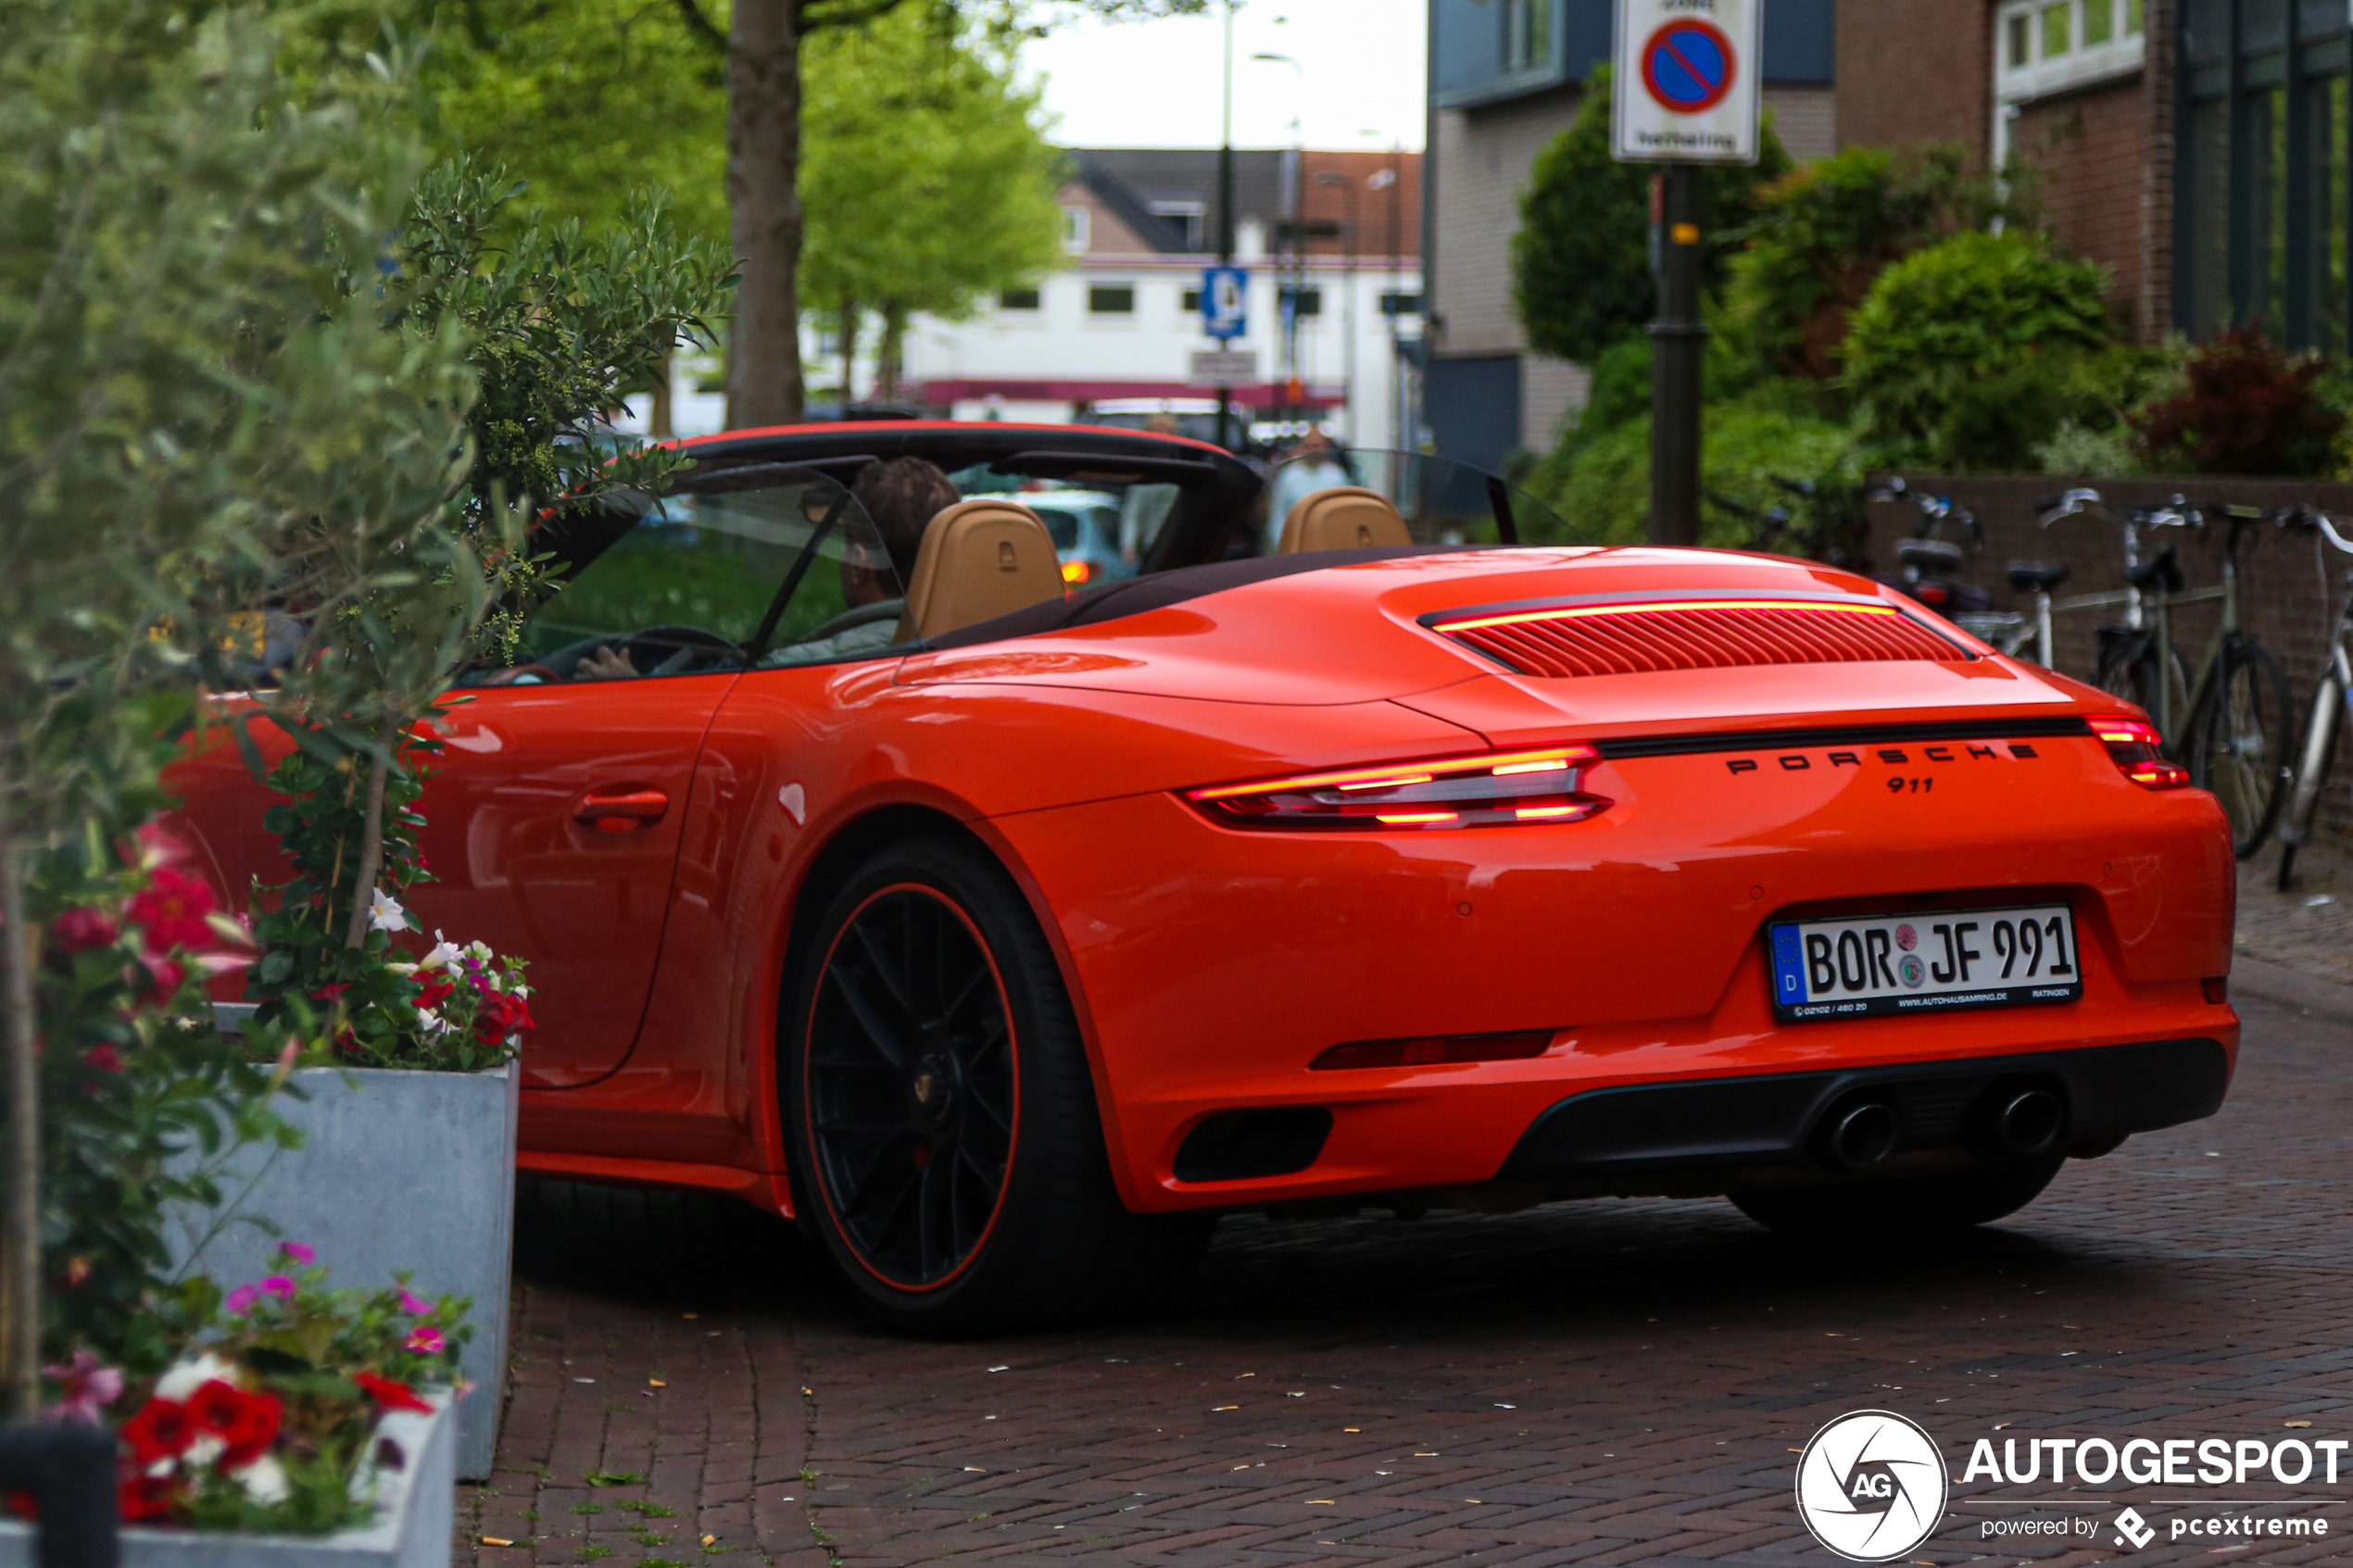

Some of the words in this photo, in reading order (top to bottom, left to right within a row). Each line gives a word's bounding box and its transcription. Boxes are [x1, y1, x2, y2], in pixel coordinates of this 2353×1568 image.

[1727, 745, 2038, 775] PORSCHE
[1886, 776, 1933, 793] 911
[1806, 928, 1897, 994] BOR
[1931, 922, 1981, 984] JF
[1992, 917, 2072, 979] 991
[1785, 975, 1797, 991] D
[1899, 993, 2007, 1007] WWW.AUTOHAUSAMRING.DE
[2032, 988, 2070, 998] RATINGEN
[1804, 1006, 1831, 1015] 02102
